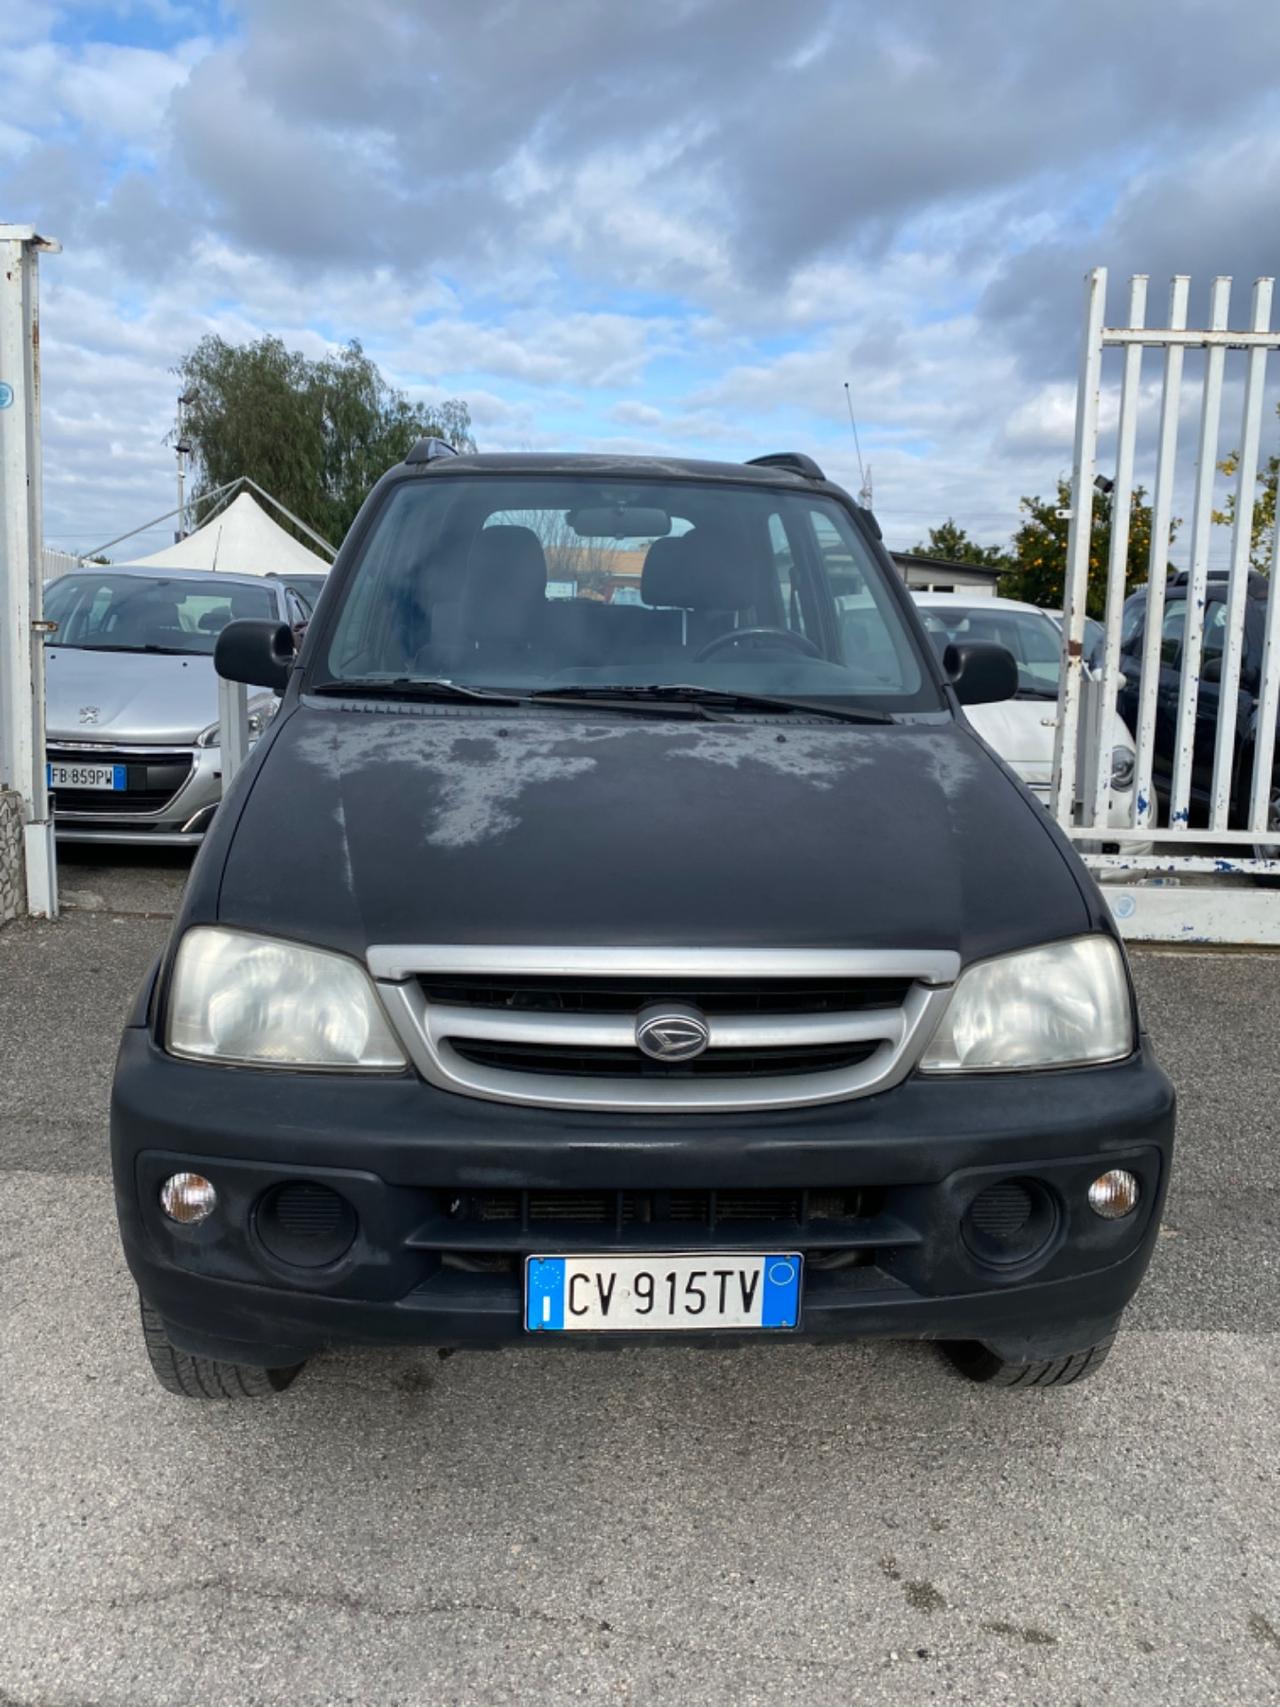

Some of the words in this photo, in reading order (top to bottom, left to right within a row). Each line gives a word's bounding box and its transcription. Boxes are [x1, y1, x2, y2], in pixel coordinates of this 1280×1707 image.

[52, 767, 67, 784] FB
[72, 768, 113, 785] 859PW
[568, 1271, 616, 1316] CV
[634, 1270, 760, 1315] 915TV
